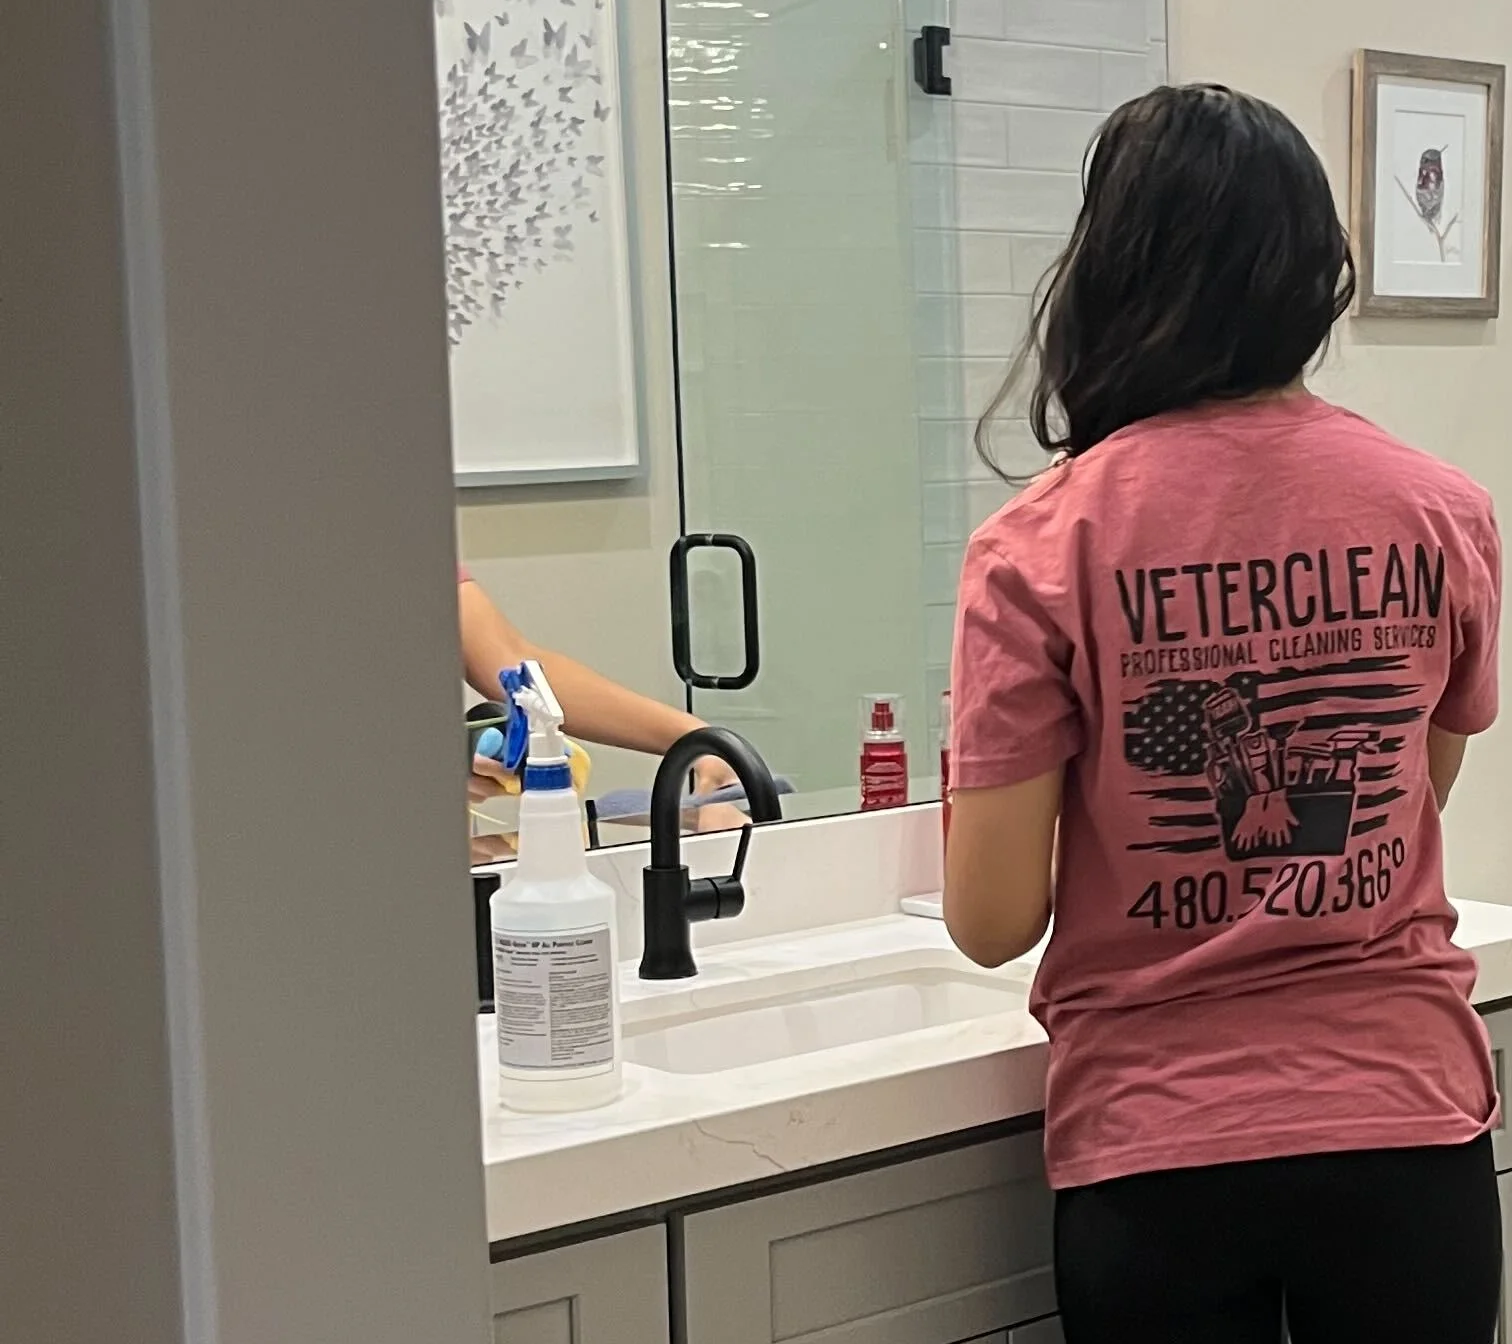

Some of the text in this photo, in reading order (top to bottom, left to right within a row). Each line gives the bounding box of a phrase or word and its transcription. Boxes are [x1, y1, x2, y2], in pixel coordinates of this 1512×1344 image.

[1115, 542, 1445, 645] VETERCLEAN
[1120, 624, 1437, 678] PROFESSIONAL CLEANING SERVICES
